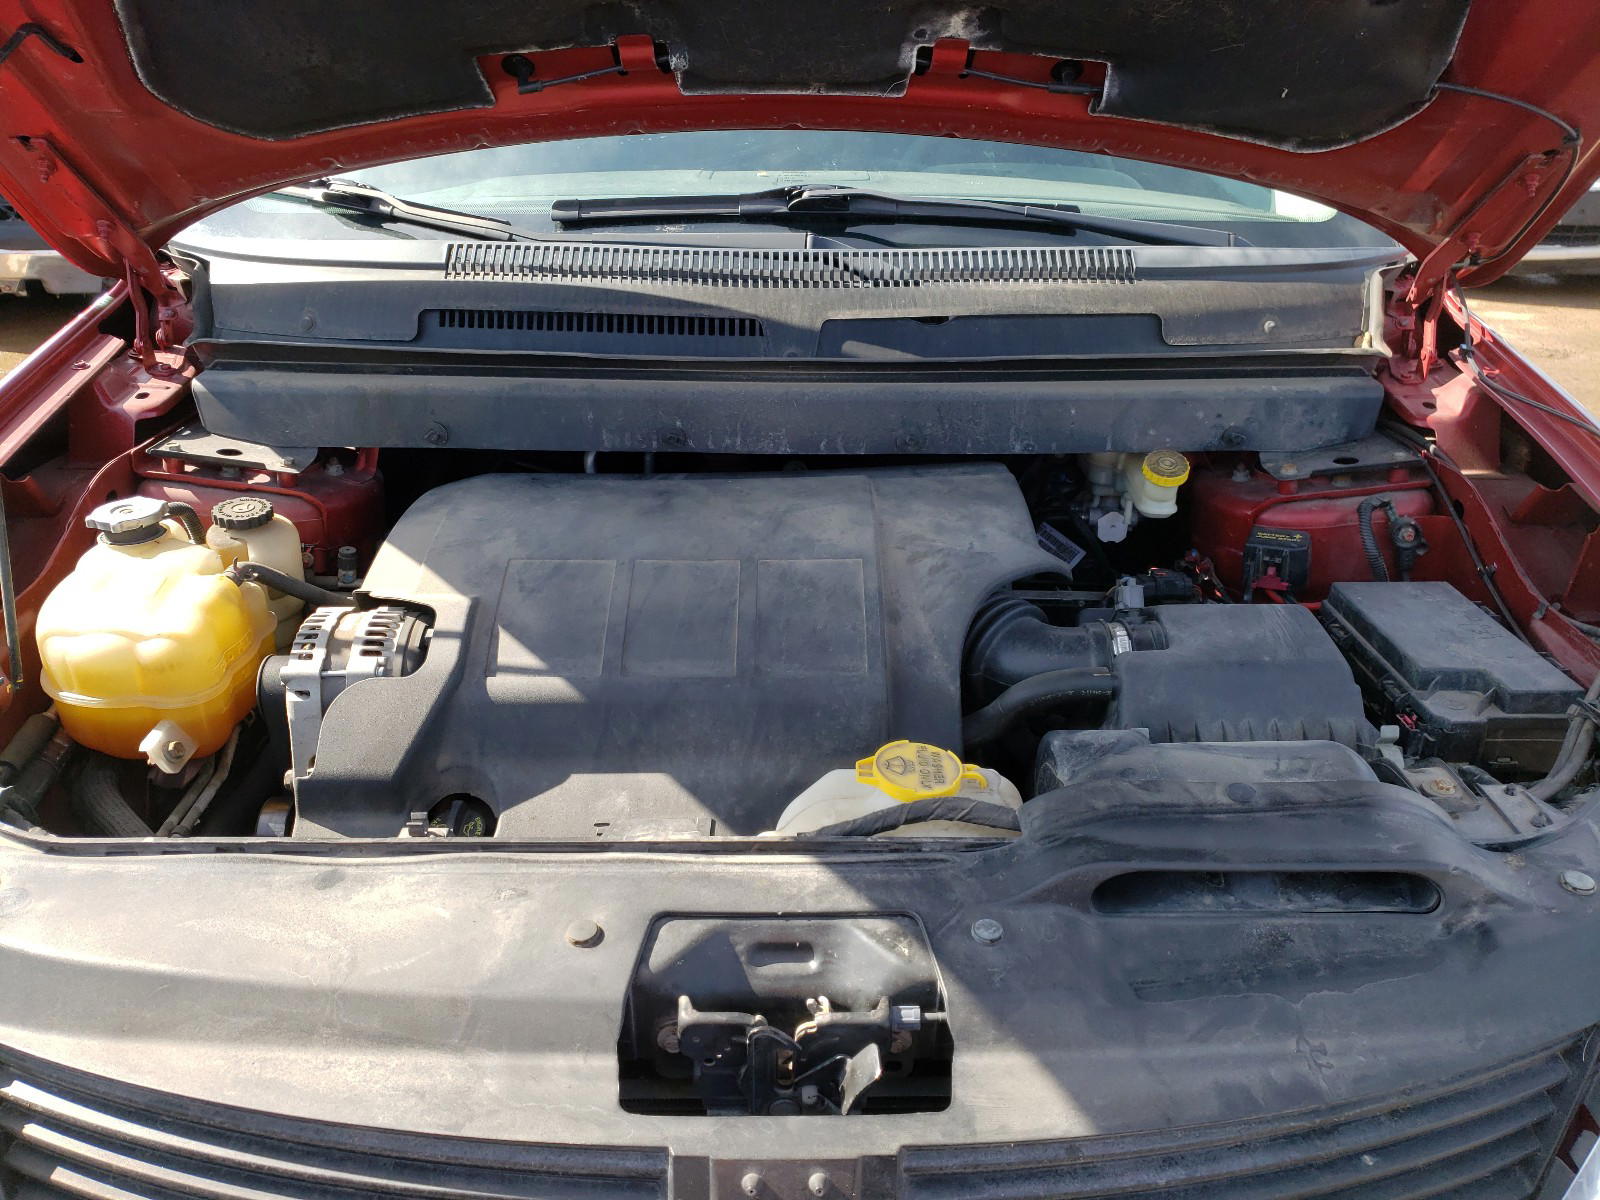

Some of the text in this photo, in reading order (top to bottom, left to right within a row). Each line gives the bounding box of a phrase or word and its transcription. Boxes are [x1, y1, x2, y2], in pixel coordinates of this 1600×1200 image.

[916, 745, 933, 790] FLUID ONLY
[930, 751, 945, 785] WASHER
